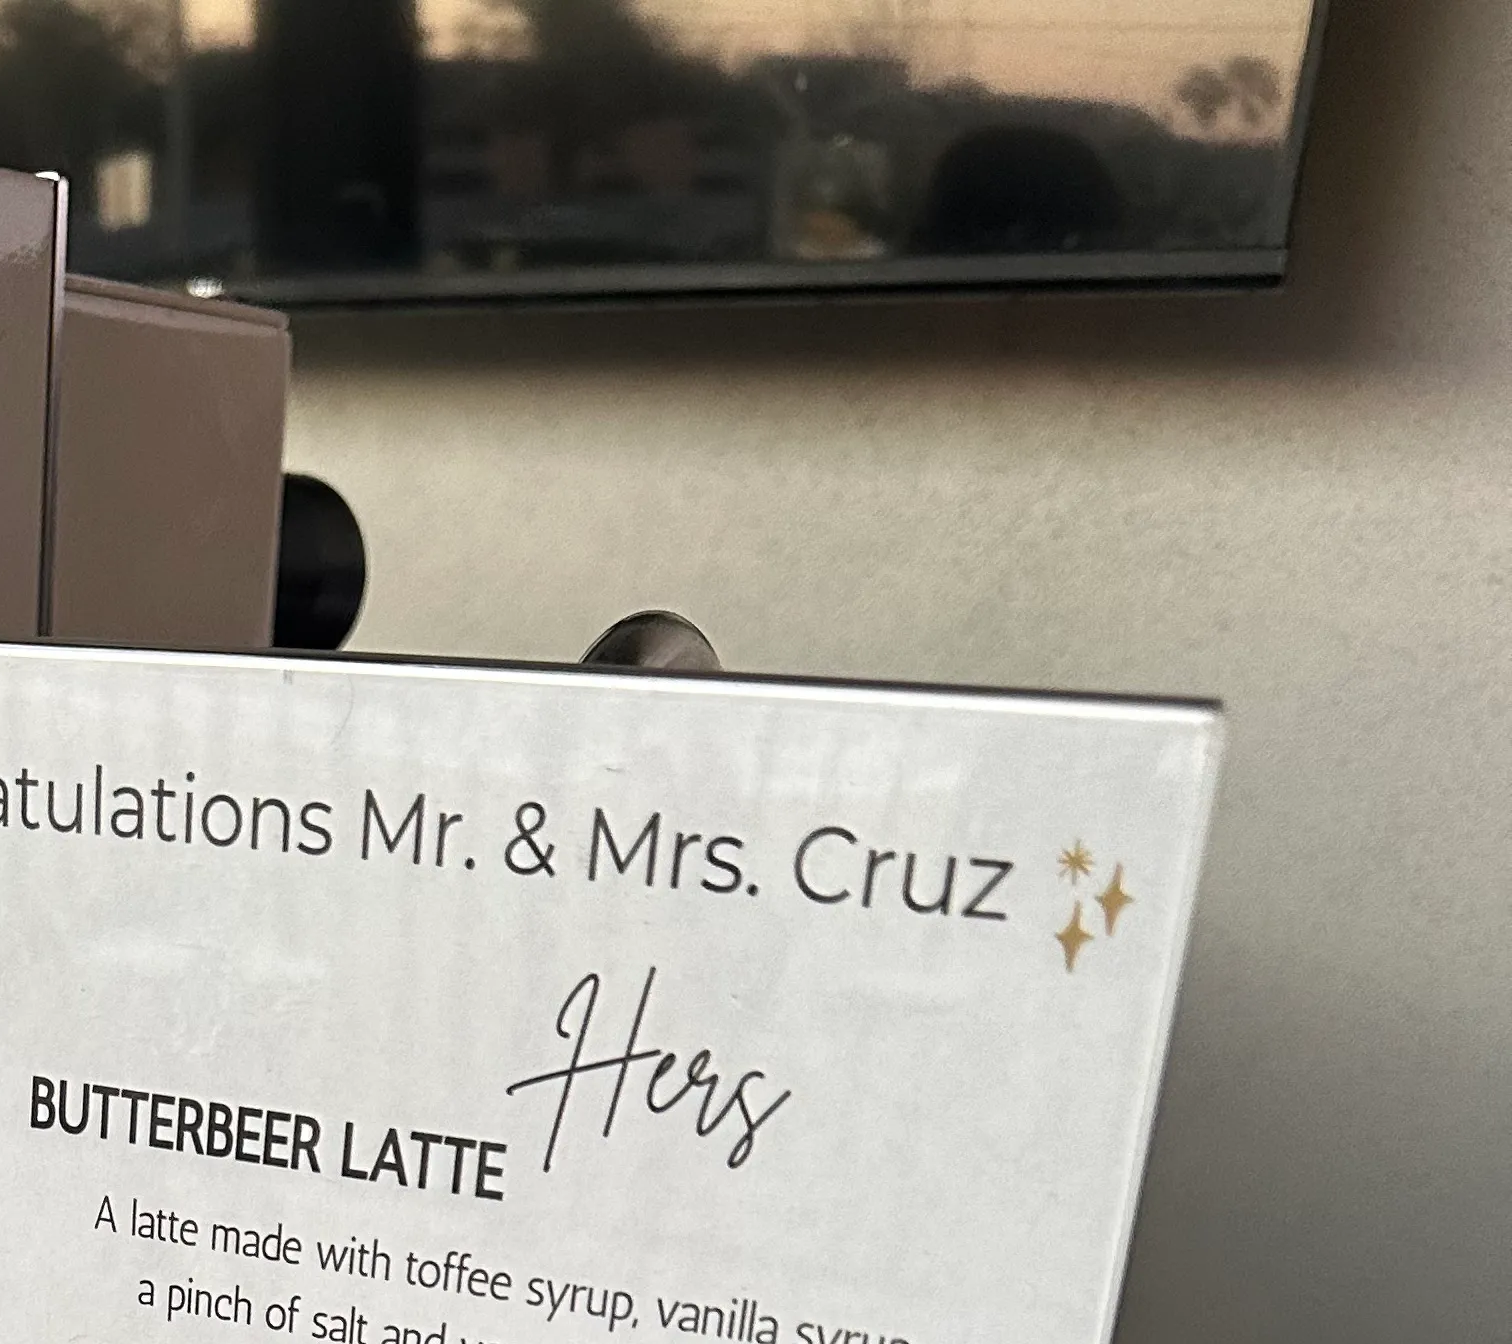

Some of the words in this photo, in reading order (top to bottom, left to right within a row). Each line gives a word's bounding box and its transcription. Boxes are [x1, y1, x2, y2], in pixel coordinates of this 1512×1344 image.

[361, 789, 475, 871] Mr.
[504, 802, 555, 879] &
[588, 808, 759, 898] Mrs.
[793, 826, 1014, 922] Cruz
[503, 965, 793, 1173] Hers
[30, 1075, 321, 1174] BUTTERBEER
[341, 1121, 508, 1202] LATTE
[94, 1195, 117, 1233] A
[131, 1198, 199, 1247] latte
[211, 1222, 302, 1265] made
[316, 1236, 391, 1282] with
[406, 1250, 512, 1301] toffee
[525, 1278, 638, 1333] syrup,
[138, 1279, 155, 1307] a
[167, 1277, 252, 1325] pinch
[265, 1295, 302, 1333] of
